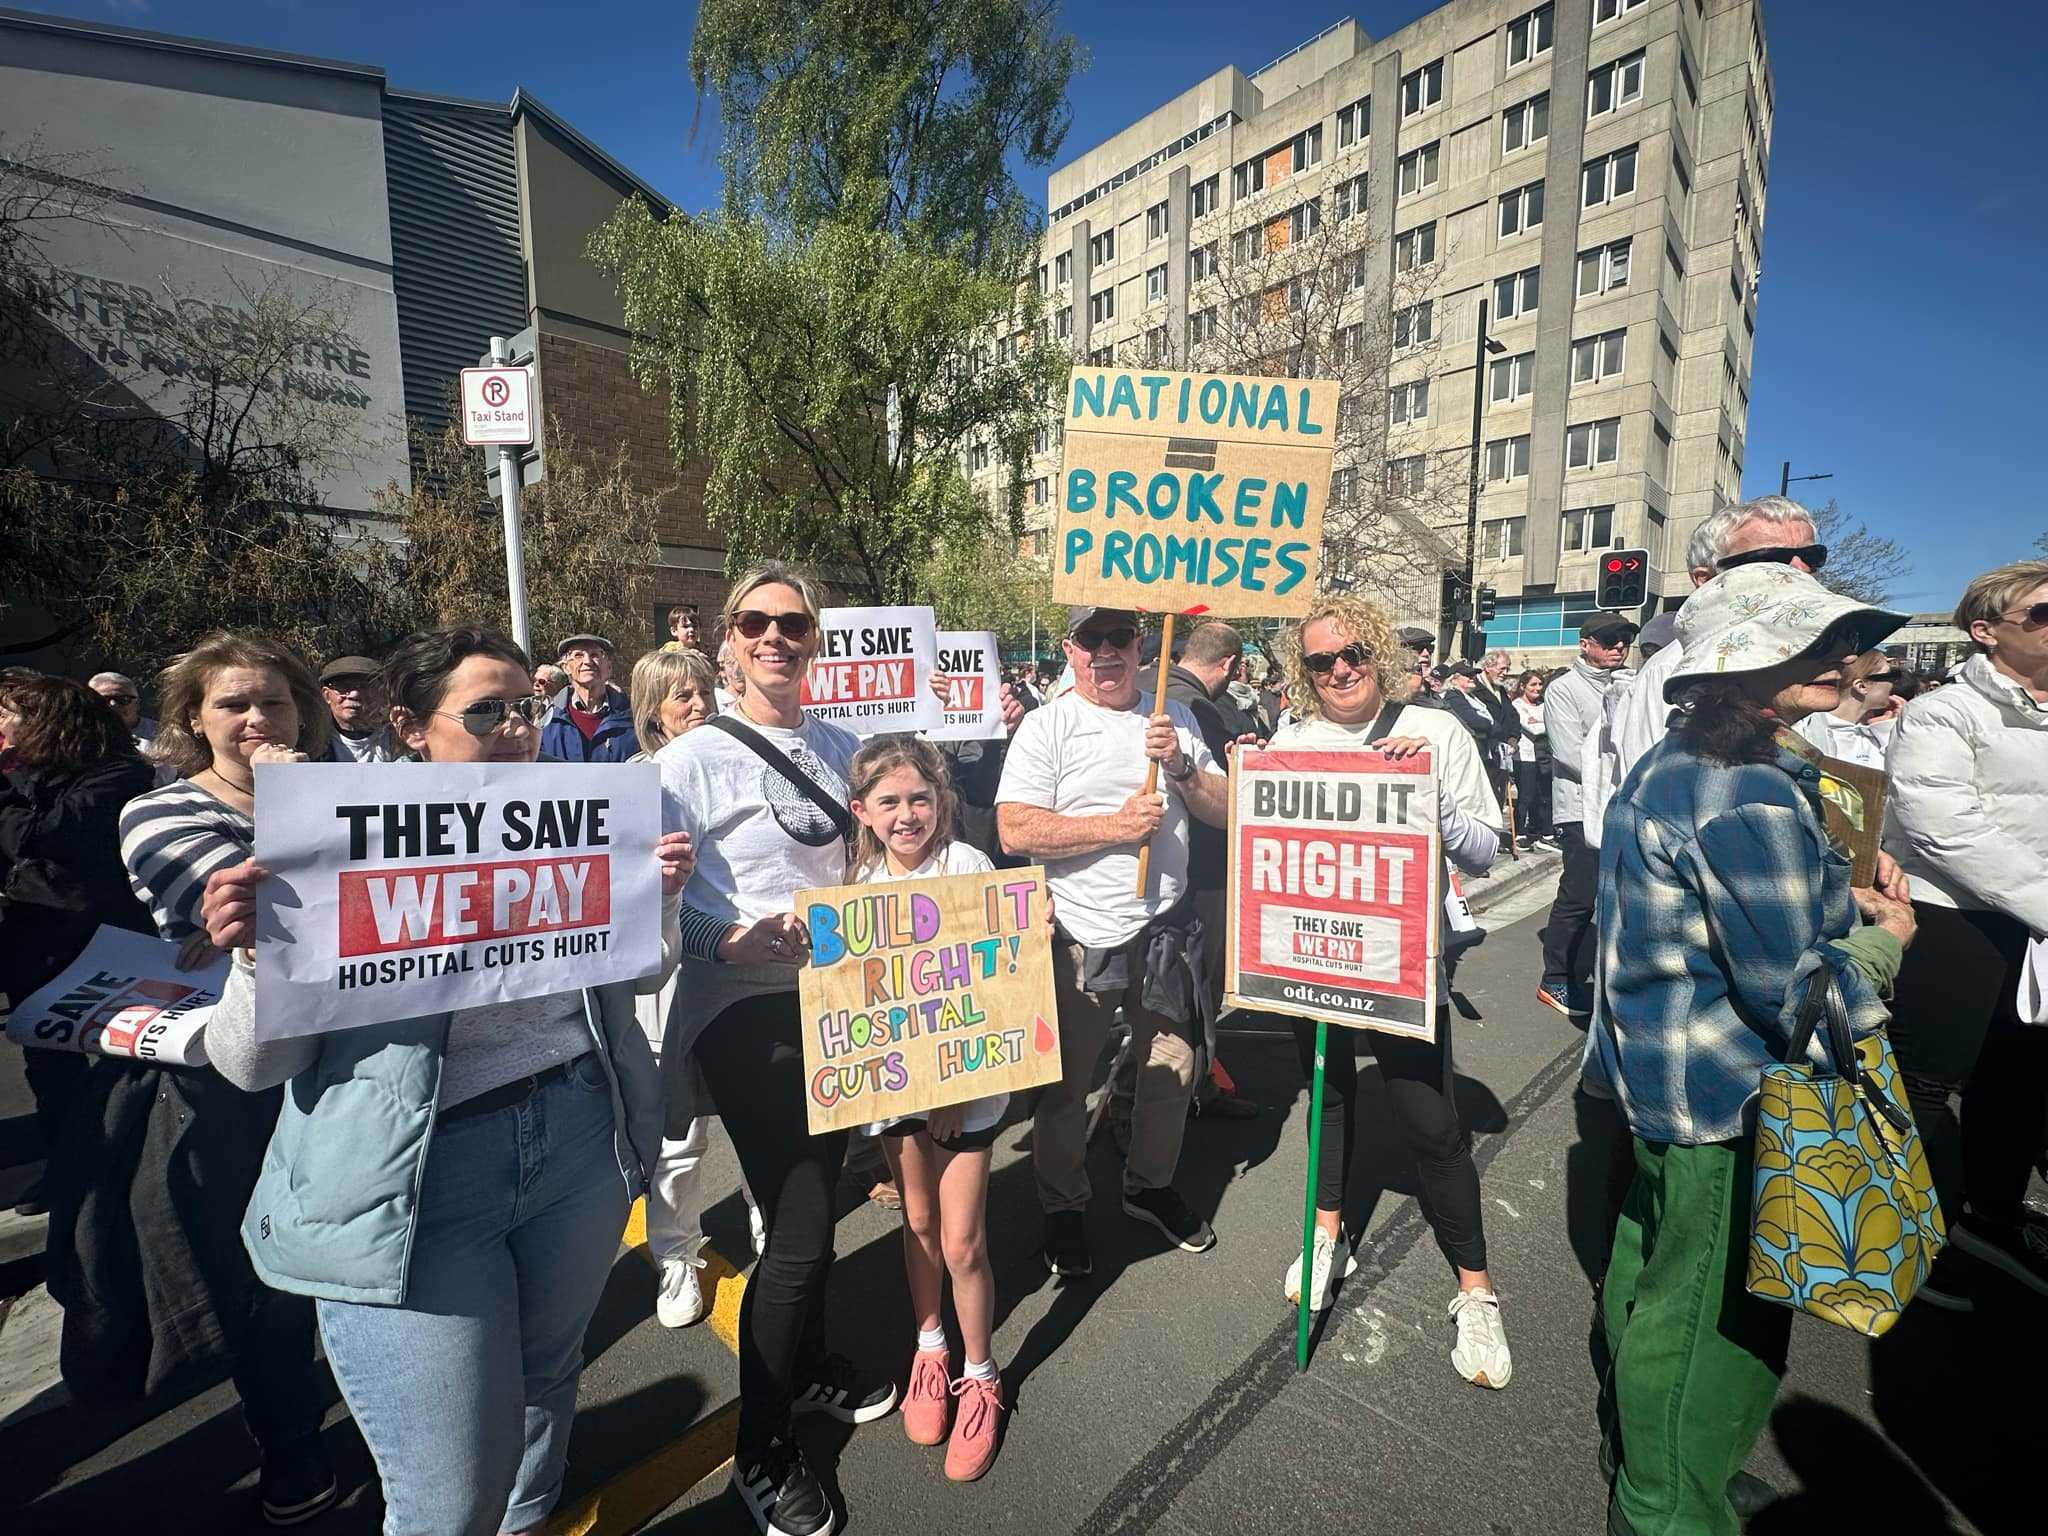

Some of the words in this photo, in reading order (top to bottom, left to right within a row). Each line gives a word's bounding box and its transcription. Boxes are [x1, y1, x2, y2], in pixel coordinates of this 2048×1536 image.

[471, 411, 491, 422] Taxi
[494, 410, 524, 422] Stand
[1072, 375, 1323, 435] NATIONAL
[1067, 468, 1309, 529] BROKEN
[1064, 528, 1311, 595] PROMISES
[818, 629, 854, 658] EY
[861, 627, 914, 656] SAVE
[938, 649, 984, 673] SAVE
[807, 665, 853, 701] WE
[858, 662, 904, 697] PAY
[856, 704, 884, 717] CUTS
[888, 701, 916, 715] HURT
[947, 679, 976, 708] AY
[943, 713, 956, 725] TS
[958, 712, 984, 724] HURT
[336, 802, 487, 861] THEY
[502, 799, 610, 851] SAVE
[1254, 780, 1361, 822] BUILD
[1376, 783, 1416, 825] IT
[1252, 837, 1414, 906] RIGHT
[366, 870, 479, 945] WE
[493, 862, 592, 932] PAY
[808, 893, 941, 969] BUILD
[984, 880, 1037, 936] IT
[1292, 915, 1327, 934] THEY
[1330, 920, 1363, 938] SAVE
[339, 950, 474, 990] HOSPITAL
[484, 940, 544, 968] CUTS
[554, 930, 611, 958] HURT
[863, 936, 1021, 1008] RIGHT!
[1292, 955, 1324, 967] HOSPITAL
[1325, 960, 1343, 970] CUTS
[1344, 963, 1363, 972] HURT
[1298, 934, 1325, 957] WE
[1327, 938, 1357, 961] PAY
[34, 970, 137, 1044] SAVE
[141, 1024, 168, 1061] UTS
[162, 989, 217, 1020] HURT
[818, 994, 986, 1059] HOSPITAL
[1283, 985, 1375, 1012] odt.co.nz
[811, 1051, 908, 1108] CUTS
[939, 1029, 1025, 1082] HURT
